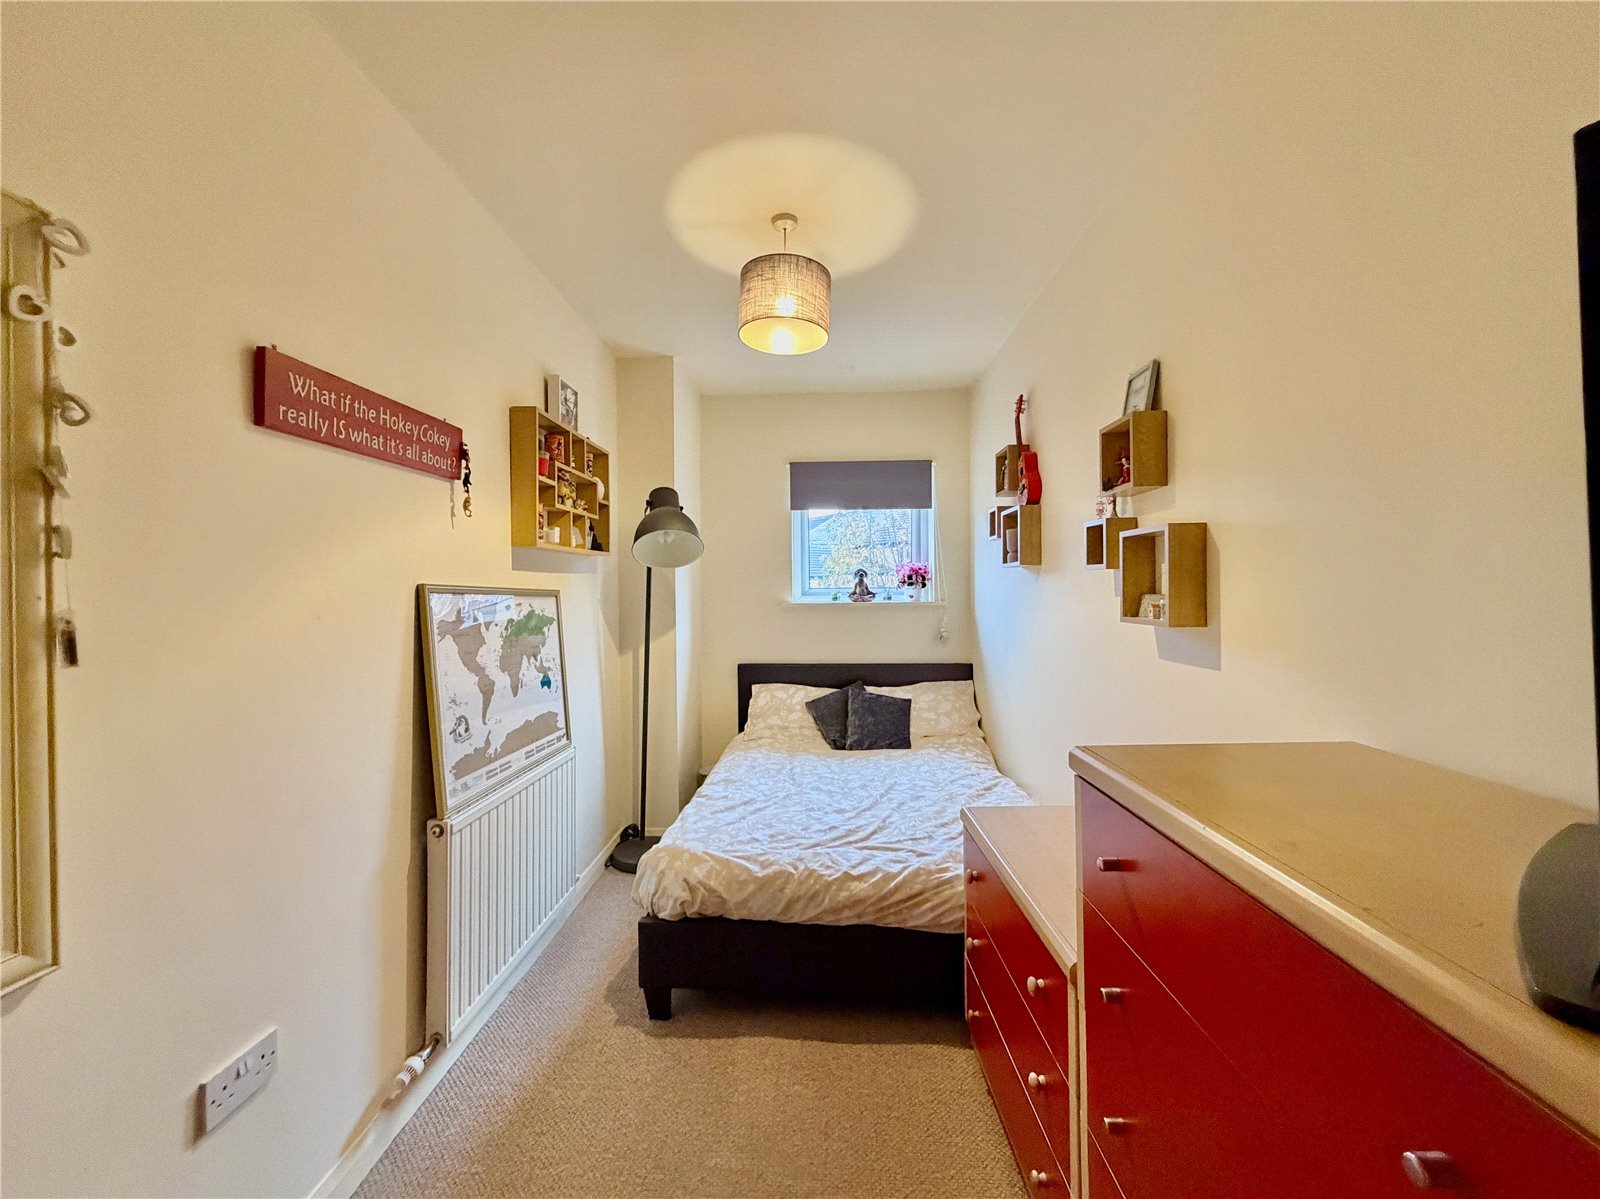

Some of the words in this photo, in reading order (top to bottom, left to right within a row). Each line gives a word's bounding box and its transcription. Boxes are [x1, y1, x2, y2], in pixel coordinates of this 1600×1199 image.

[279, 404, 329, 437] really
[333, 418, 345, 438] IS
[349, 428, 384, 451] what
[387, 436, 403, 456] it's
[405, 445, 419, 461] all
[421, 449, 457, 472] about?
[288, 372, 336, 409] What
[340, 393, 351, 413] if
[354, 400, 377, 423] the
[380, 407, 419, 440] Hokey
[420, 425, 451, 451] Cokey
